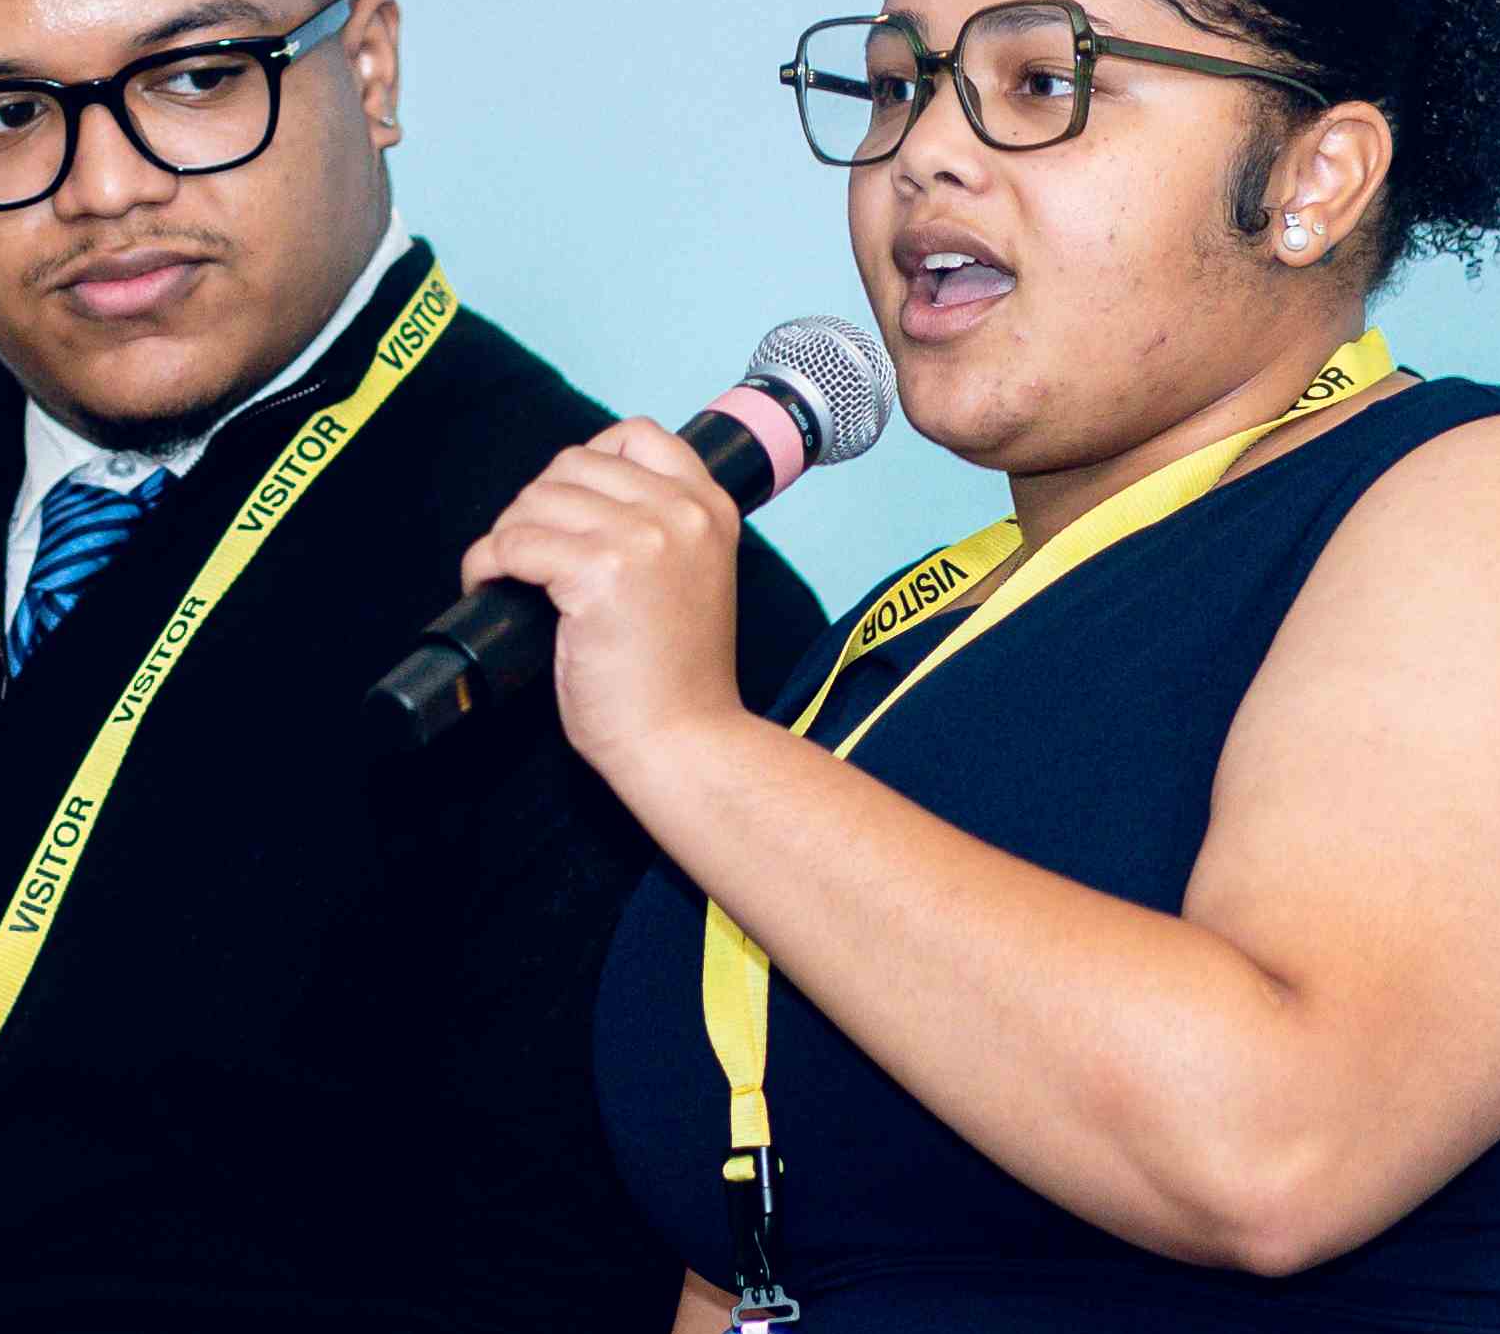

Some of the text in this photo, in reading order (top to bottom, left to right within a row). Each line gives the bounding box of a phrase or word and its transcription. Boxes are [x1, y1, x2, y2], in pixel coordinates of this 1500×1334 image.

[237, 415, 348, 532] VISITOR
[113, 596, 207, 724] VISITOR
[863, 558, 968, 645] VISITOR
[9, 796, 94, 932] VISITOR
